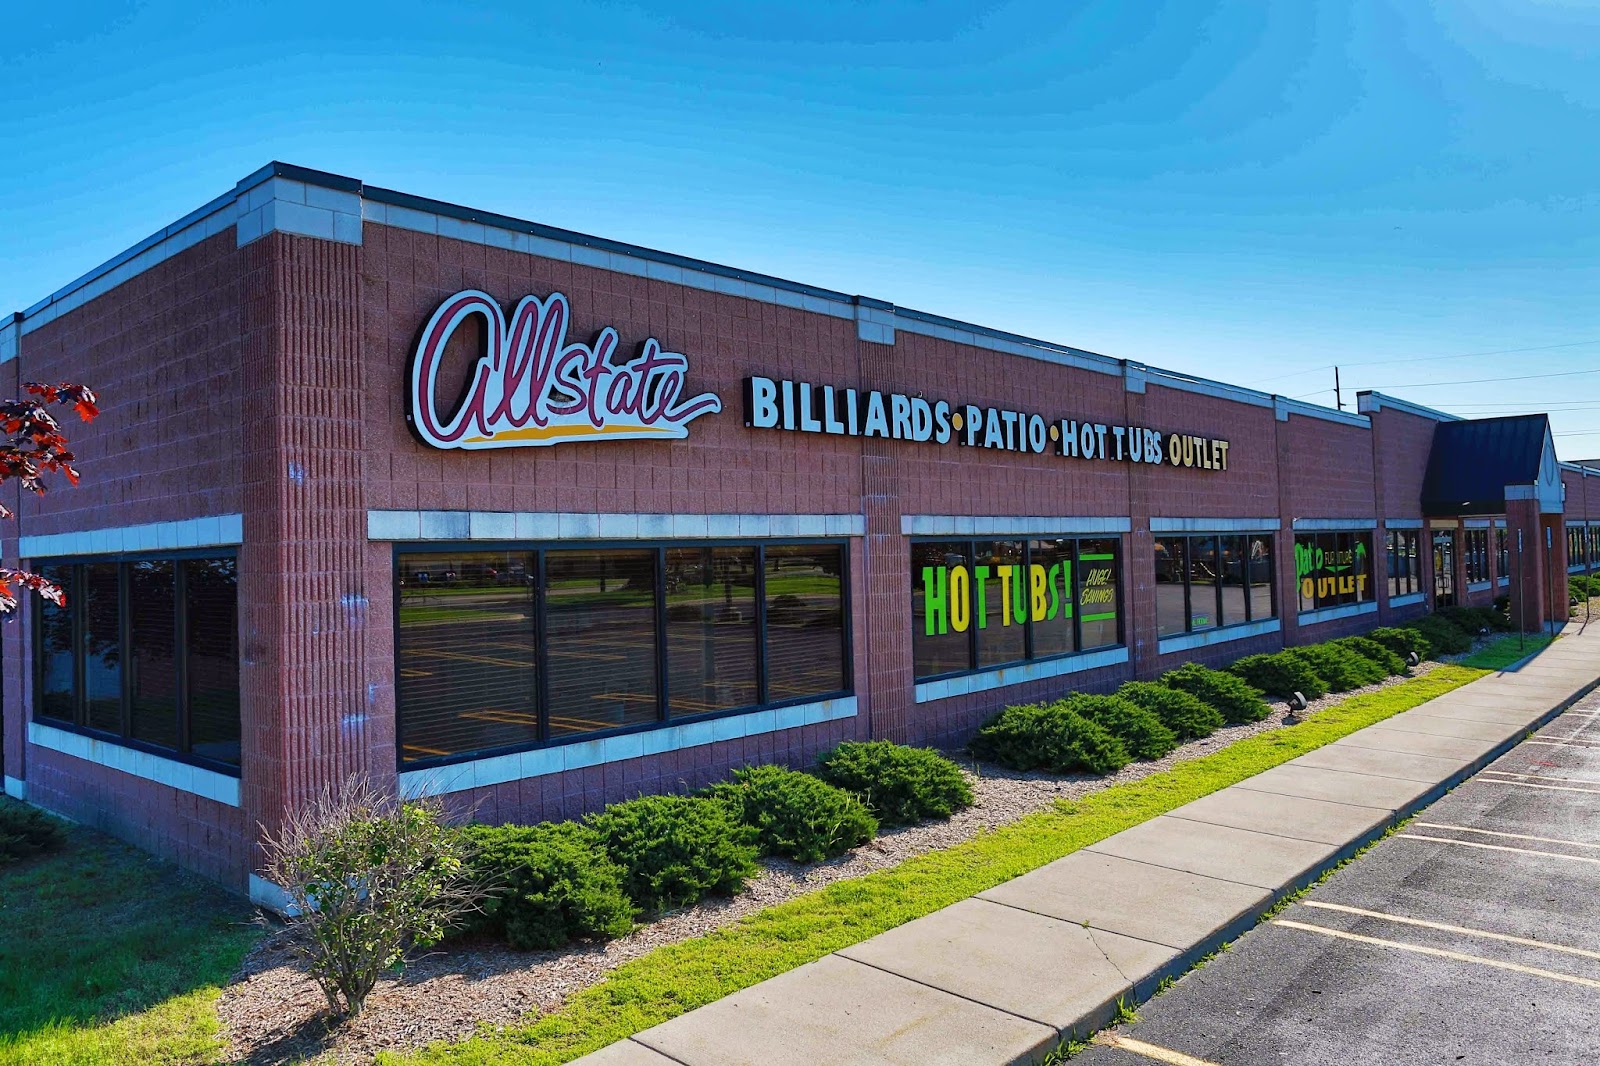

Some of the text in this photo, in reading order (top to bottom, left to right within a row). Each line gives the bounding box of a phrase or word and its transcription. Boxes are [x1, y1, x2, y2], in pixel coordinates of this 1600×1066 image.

[751, 376, 1229, 470] BILLIARDS PATIO HOT TUBS OUTLET
[922, 560, 1072, 636] HOT TUBS!
[1080, 588, 1113, 605] SAVINGS
[1302, 574, 1367, 599] OUTLET
